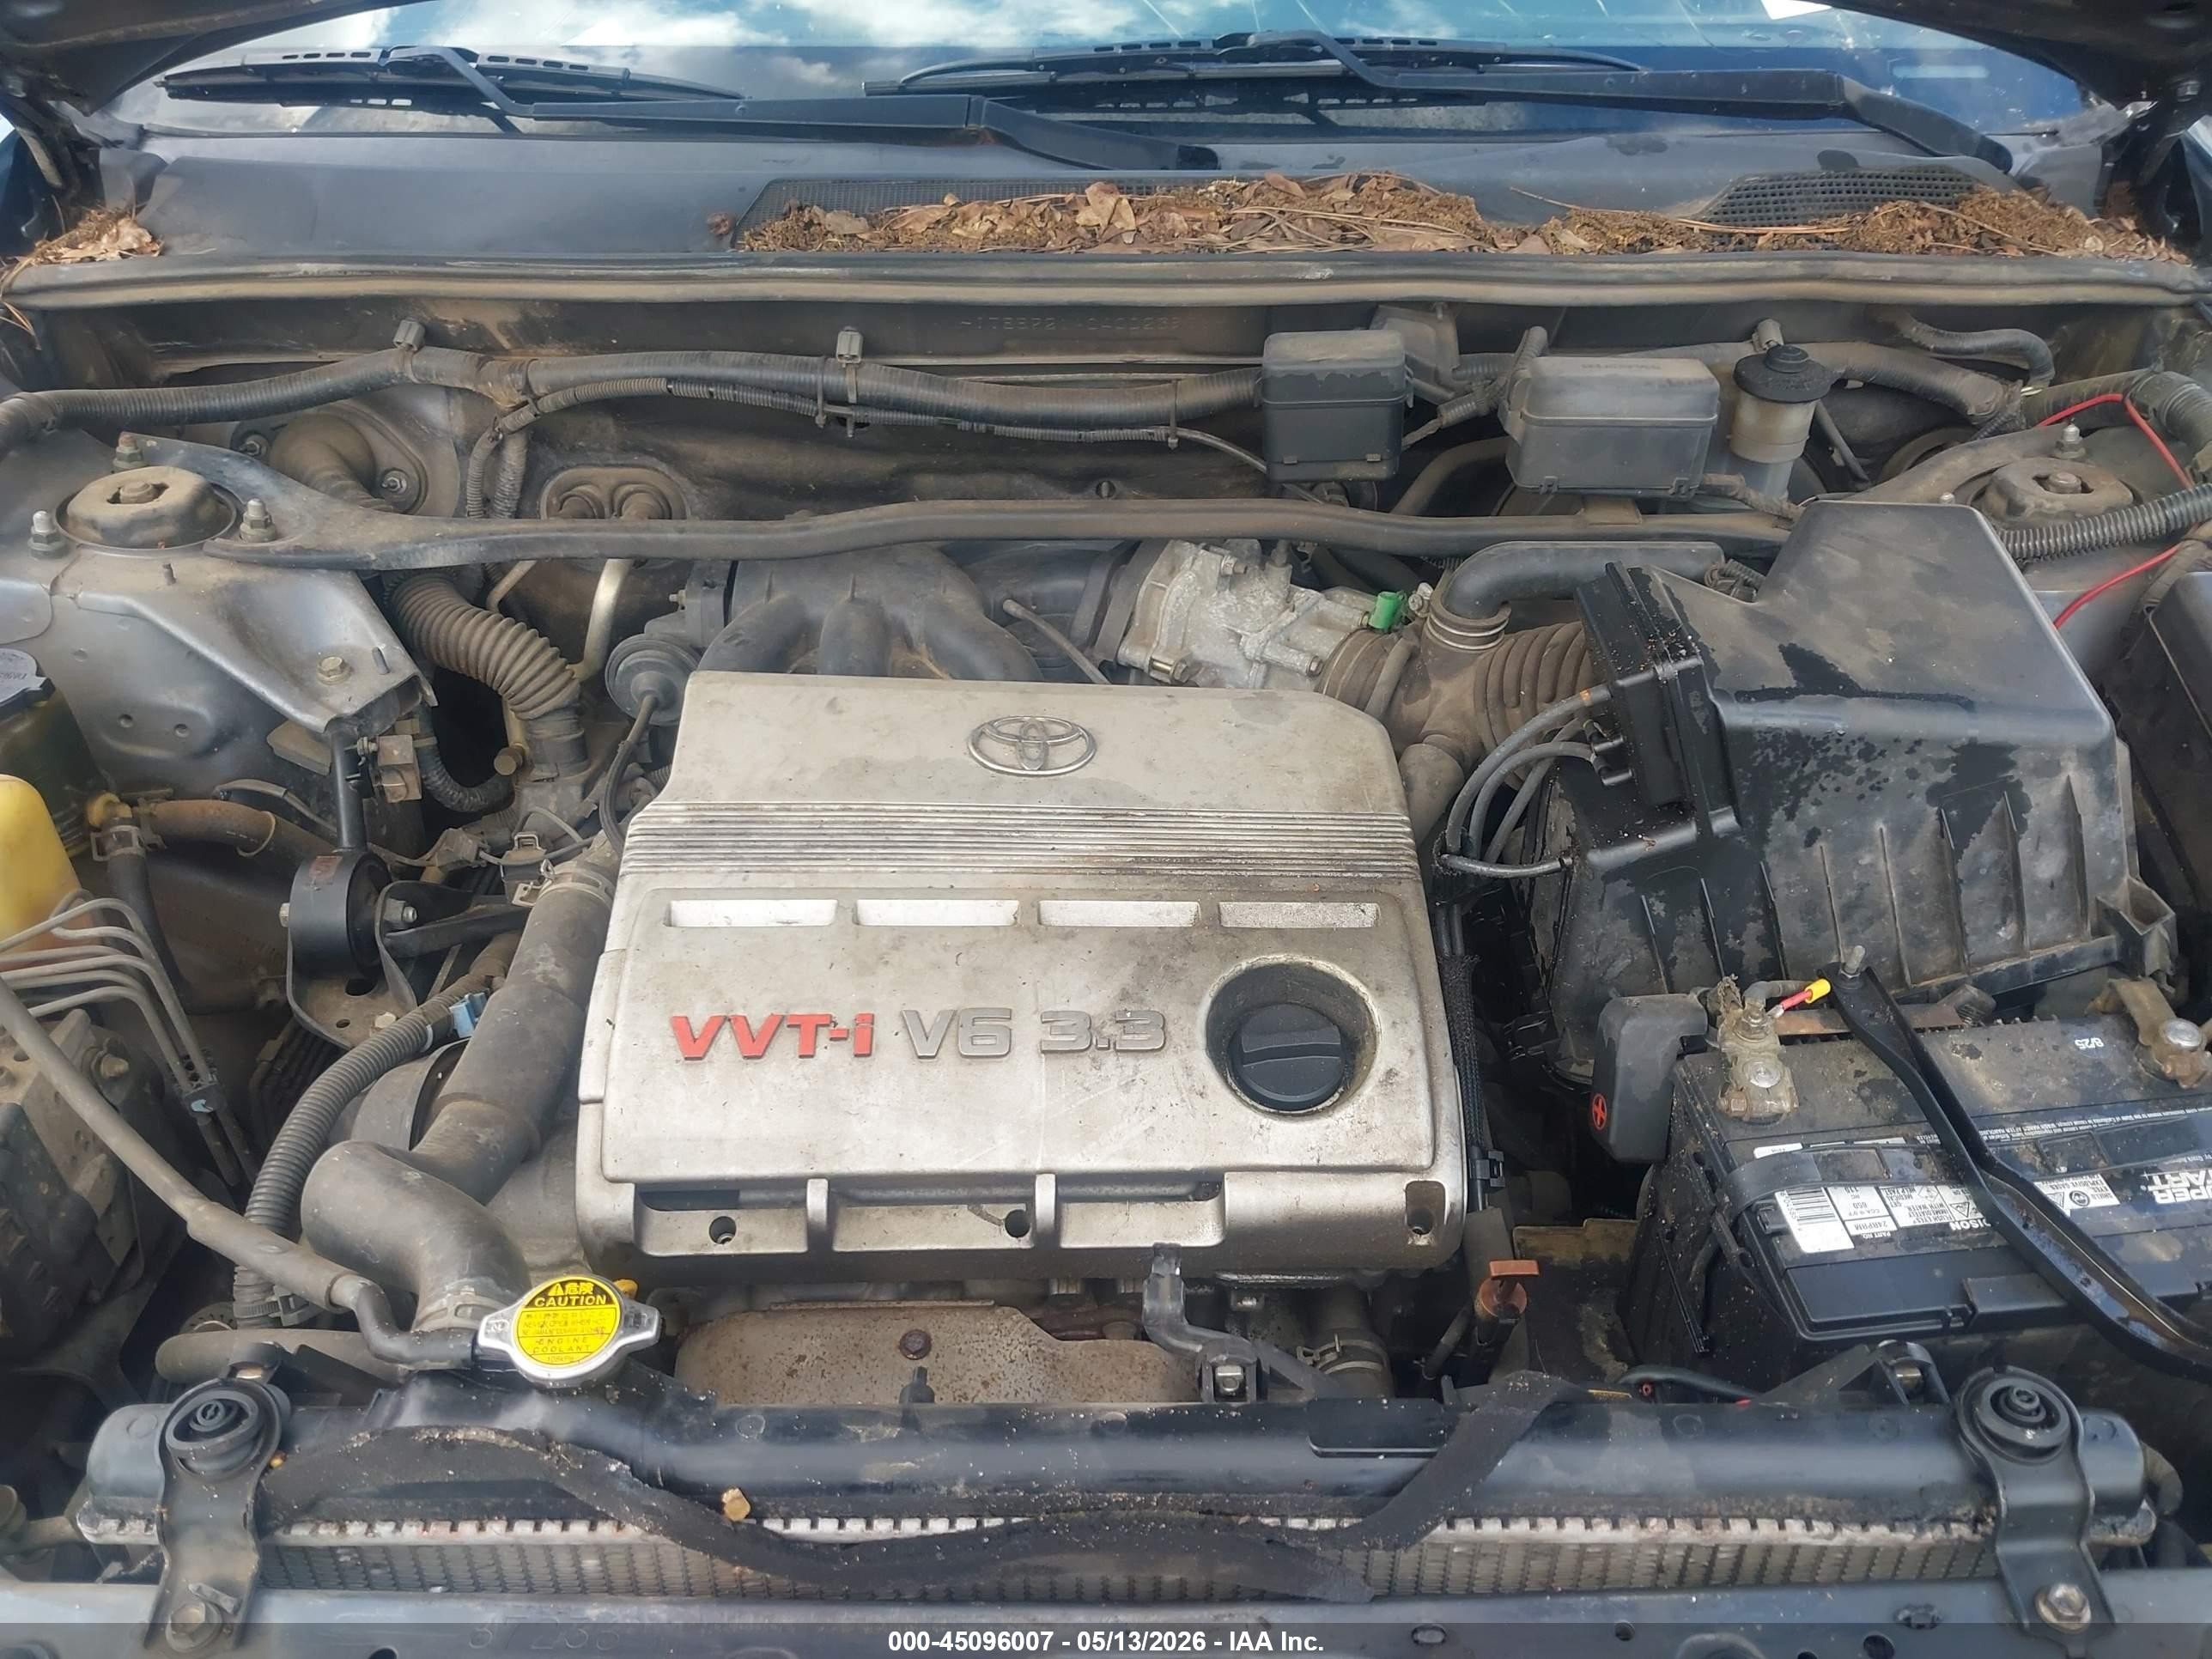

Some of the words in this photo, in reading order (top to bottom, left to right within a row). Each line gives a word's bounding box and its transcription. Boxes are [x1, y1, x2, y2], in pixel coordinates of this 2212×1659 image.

[670, 1012, 875, 1060] VVT-i
[900, 1007, 1012, 1059] V6
[1039, 1010, 1167, 1054] 3.3
[2074, 1037, 2105, 1049] 8/25
[1907, 1208, 1949, 1218] IMMEDIATELY
[534, 1295, 607, 1307] CAUTION
[537, 1336, 589, 1346] ENGINE
[532, 1345, 592, 1354] COOLANT
